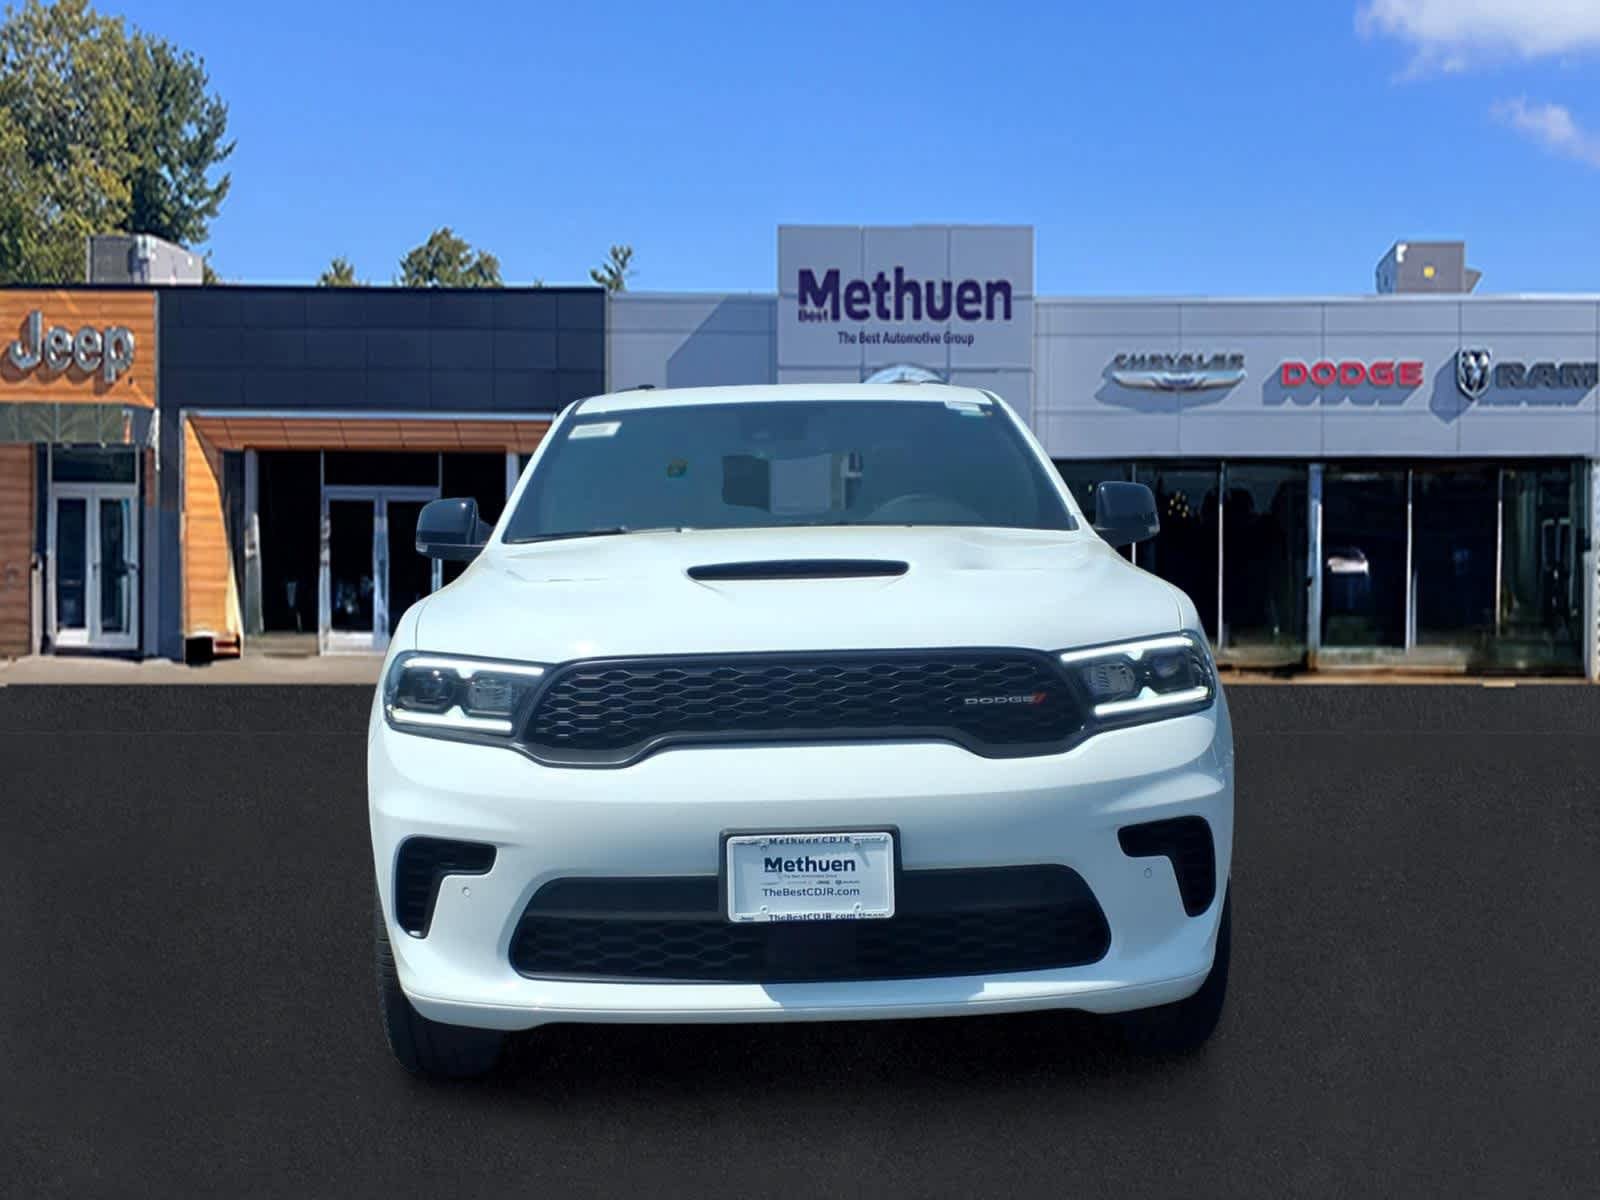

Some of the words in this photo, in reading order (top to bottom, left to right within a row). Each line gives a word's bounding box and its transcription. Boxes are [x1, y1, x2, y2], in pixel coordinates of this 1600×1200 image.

[798, 266, 1012, 322] Methuen
[9, 310, 135, 384] Jeep
[838, 331, 857, 345] The
[859, 331, 881, 345] Best
[883, 331, 941, 345] Automotive
[943, 331, 975, 347] Group
[1281, 361, 1424, 387] DODGE
[1496, 362, 1599, 389] RAM
[964, 696, 1034, 705] DODGE
[769, 836, 819, 845] Methuen
[821, 836, 851, 844] CDJR
[764, 856, 856, 873] Methuen
[762, 887, 861, 897] TheBestCDJR.com
[768, 912, 857, 922] TheBestCDJR.com
